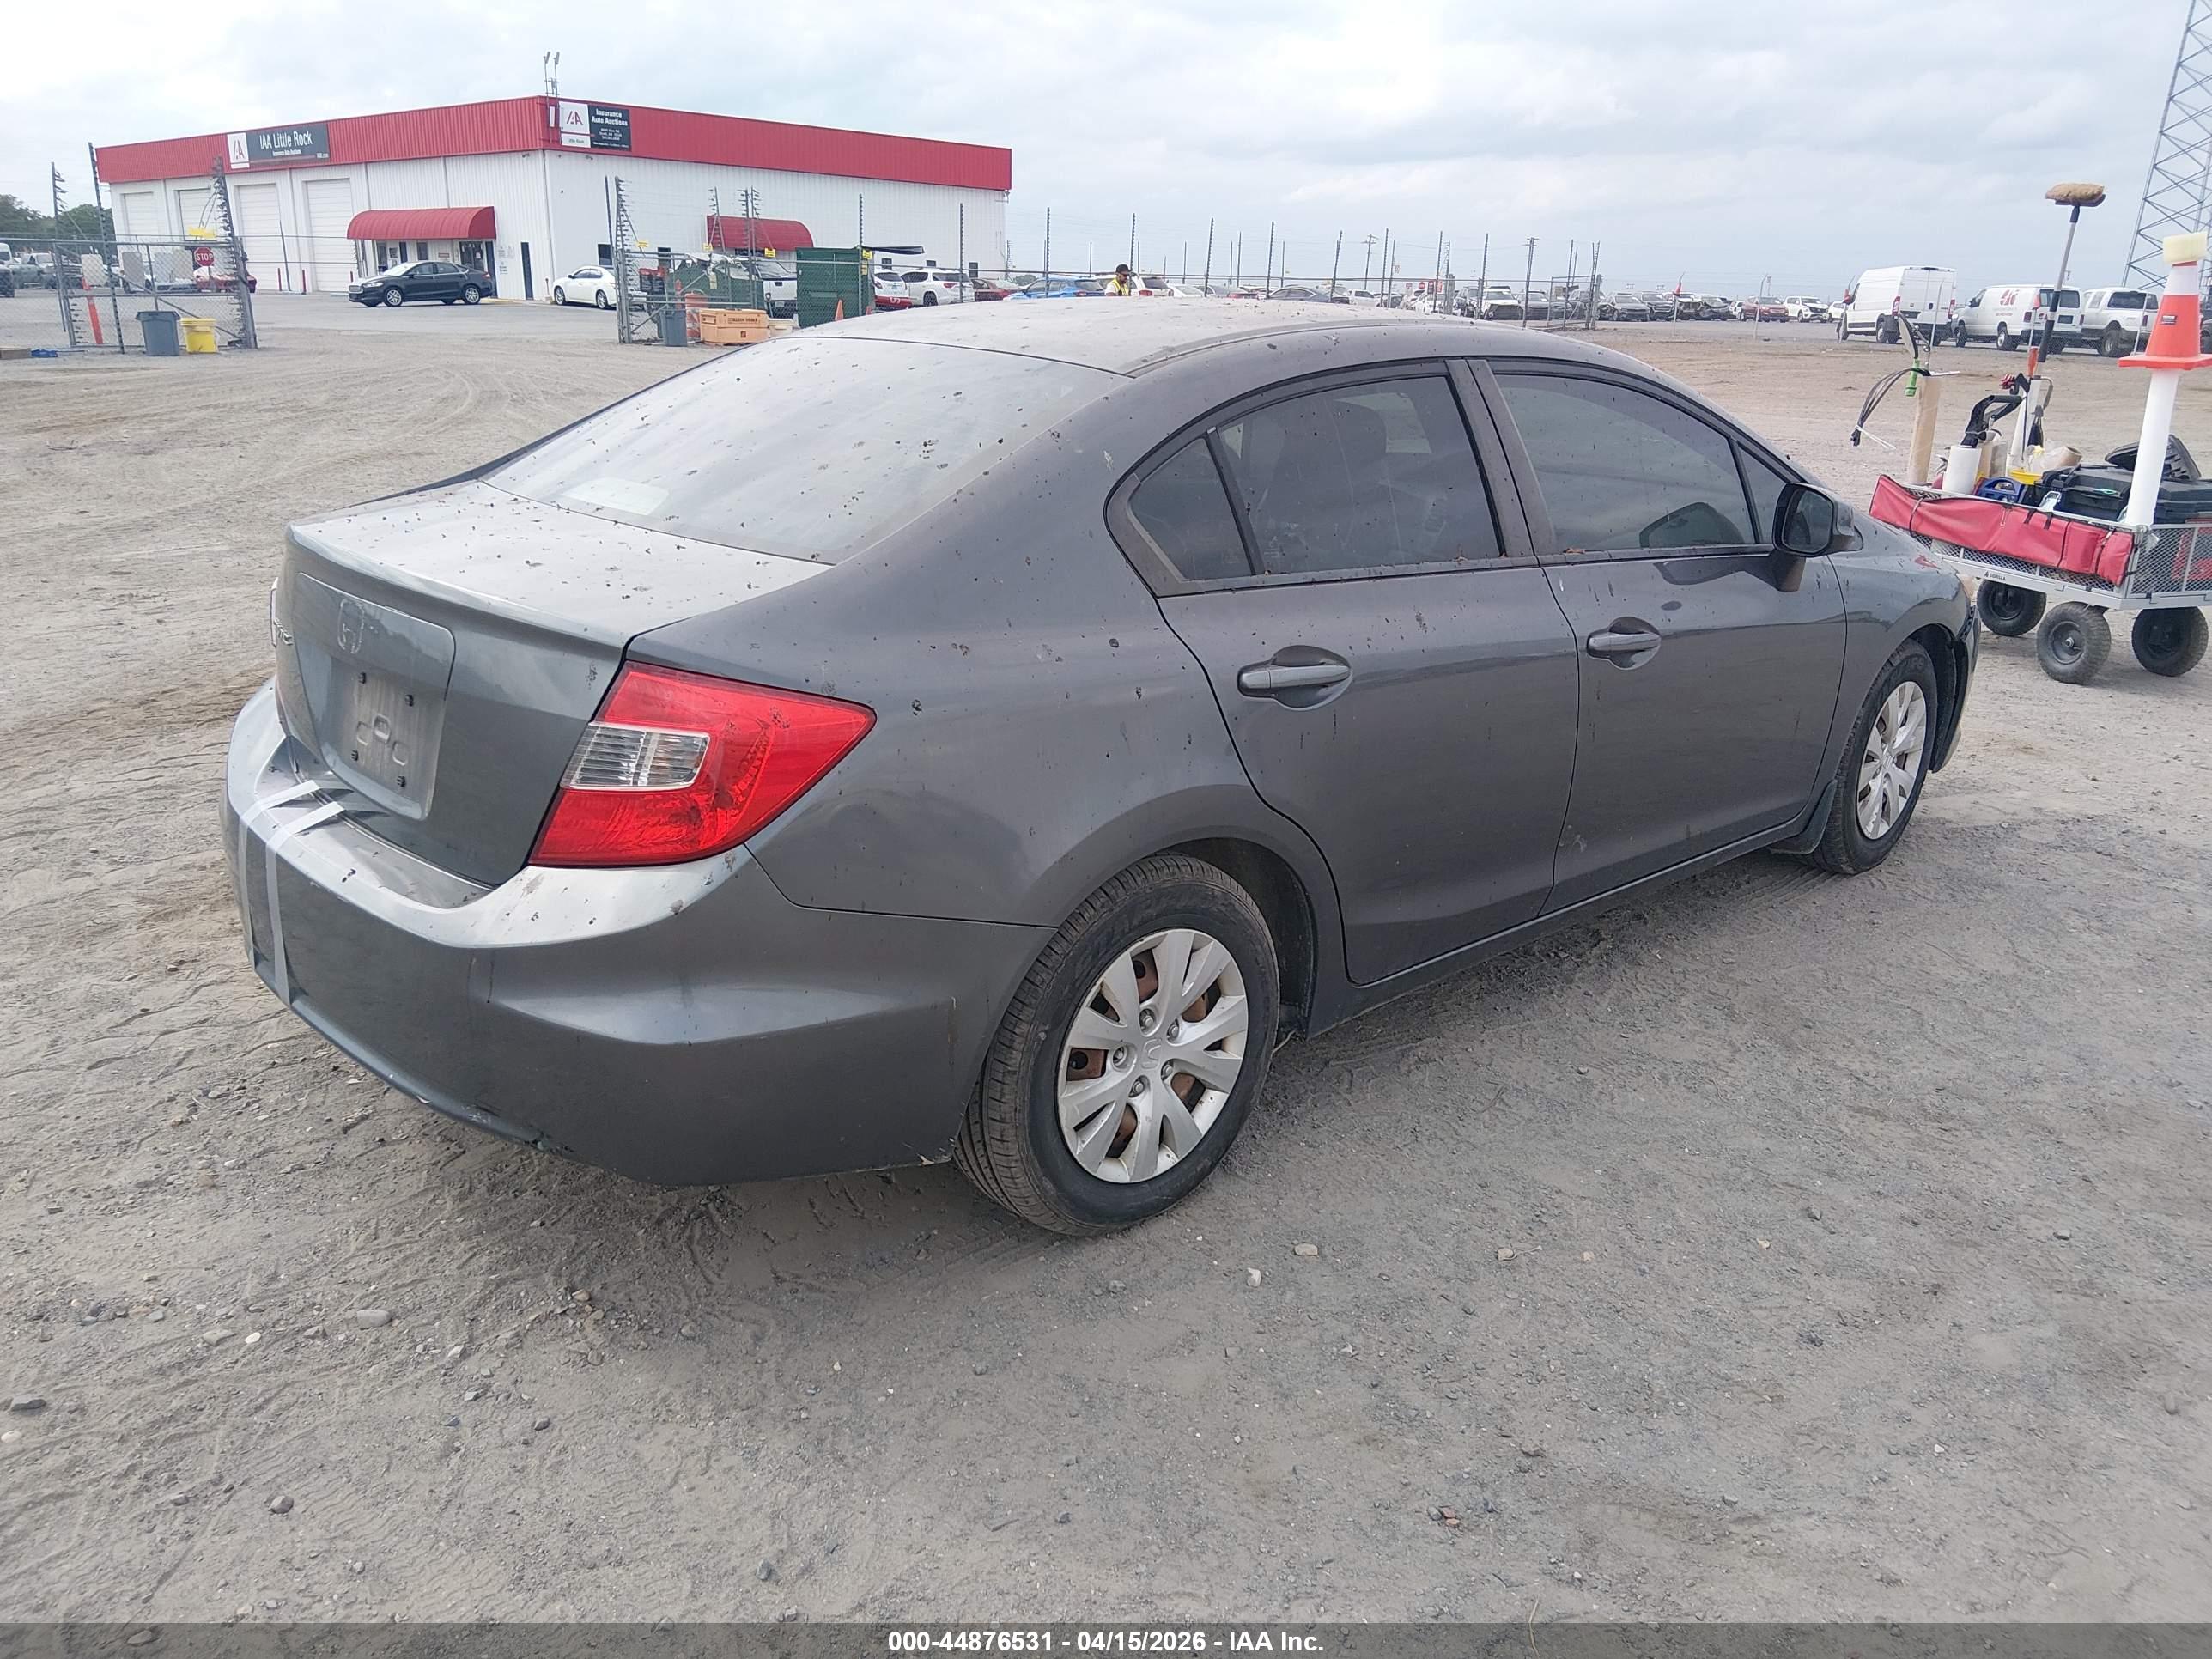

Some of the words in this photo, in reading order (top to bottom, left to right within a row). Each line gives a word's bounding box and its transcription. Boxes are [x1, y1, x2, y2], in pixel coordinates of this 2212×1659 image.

[596, 108, 623, 118] Insurance
[605, 117, 629, 126] Auctions
[259, 134, 272, 149] IAA
[273, 132, 292, 149] Little
[293, 130, 313, 146] Rock
[197, 252, 214, 261] STOP
